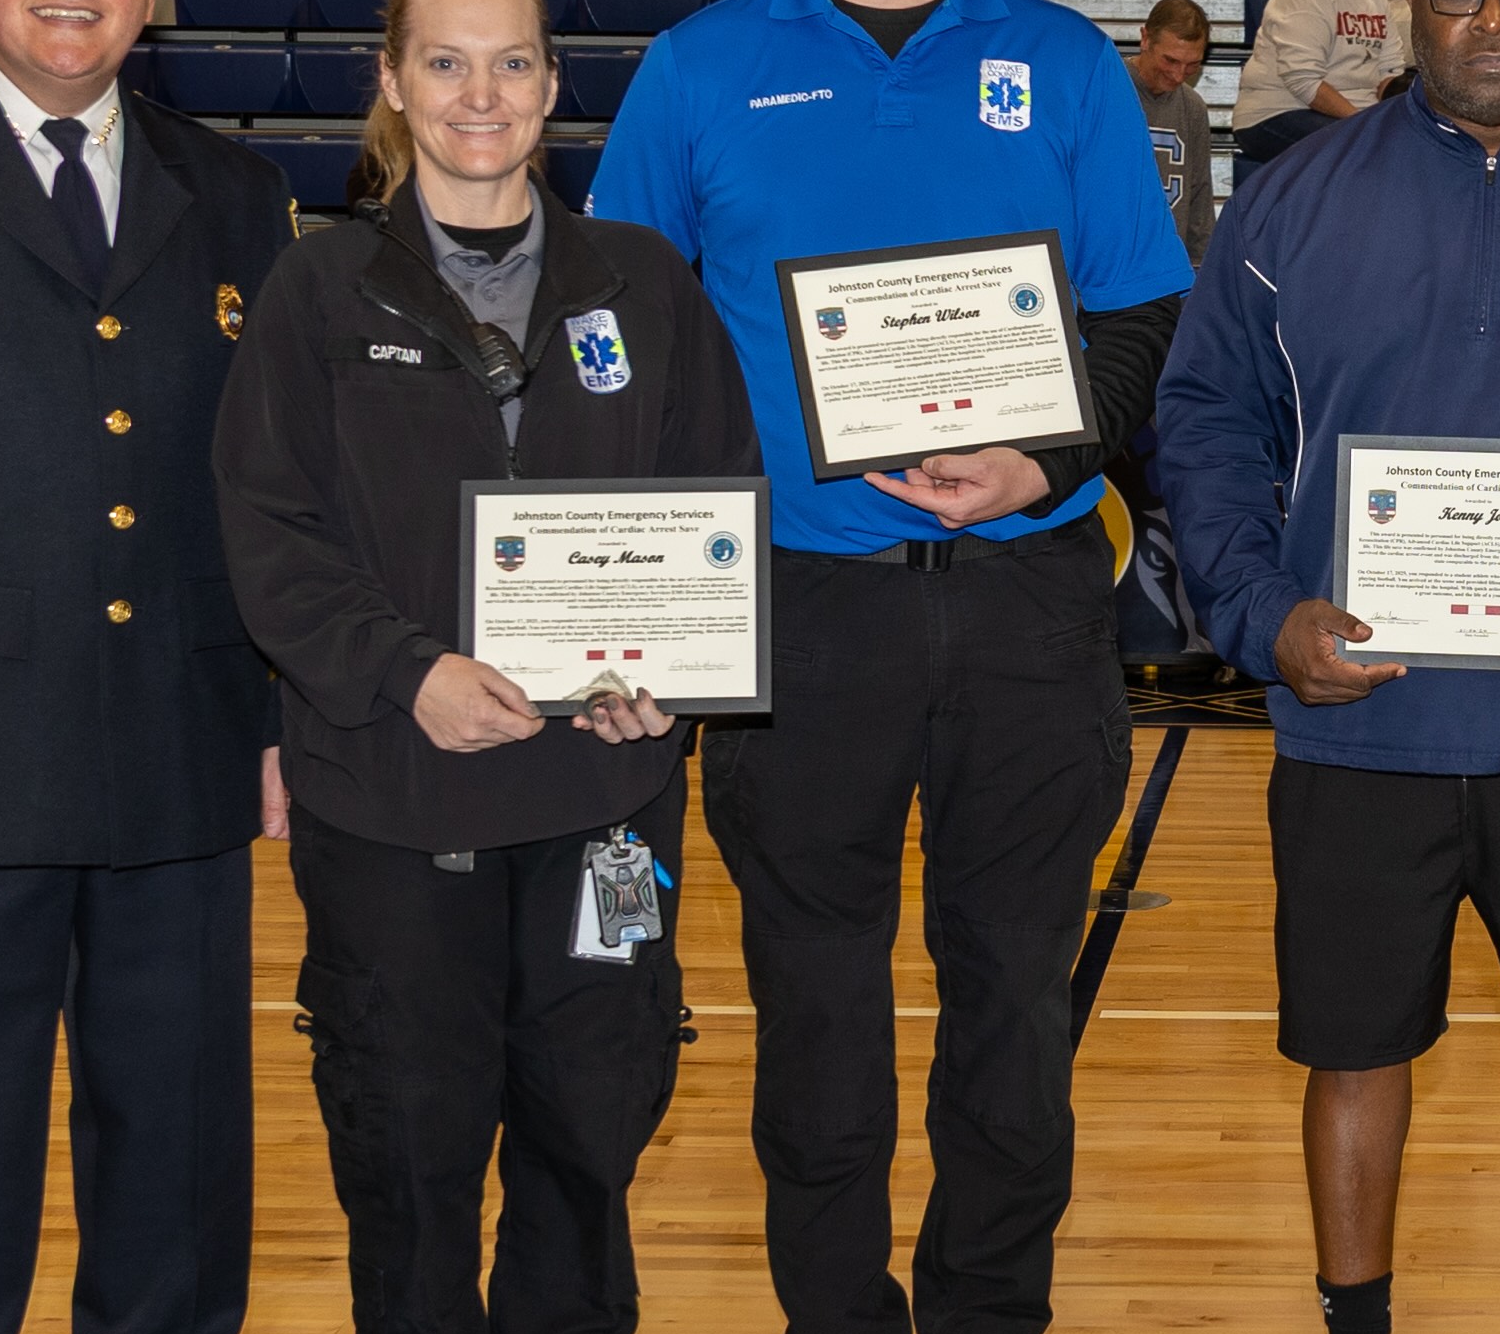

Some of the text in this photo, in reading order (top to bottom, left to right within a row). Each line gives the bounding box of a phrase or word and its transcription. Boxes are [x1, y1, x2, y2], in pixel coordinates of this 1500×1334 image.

[986, 61, 1024, 74] WAKE
[749, 88, 833, 109] PARAMEDIC-FTO
[986, 113, 1024, 128] EMS
[829, 264, 1013, 294] Johnston County Emergency Services
[845, 280, 1002, 305] Commendation of Cardiac Arrest Save
[881, 307, 981, 331] Stephen Wilson
[369, 345, 421, 364] CAPTAIN
[586, 371, 626, 389] EMS
[1386, 466, 1432, 477] Johnston
[1435, 467, 1472, 479] County
[1439, 507, 1482, 525] Kenny
[568, 551, 665, 568] Casey Mason
